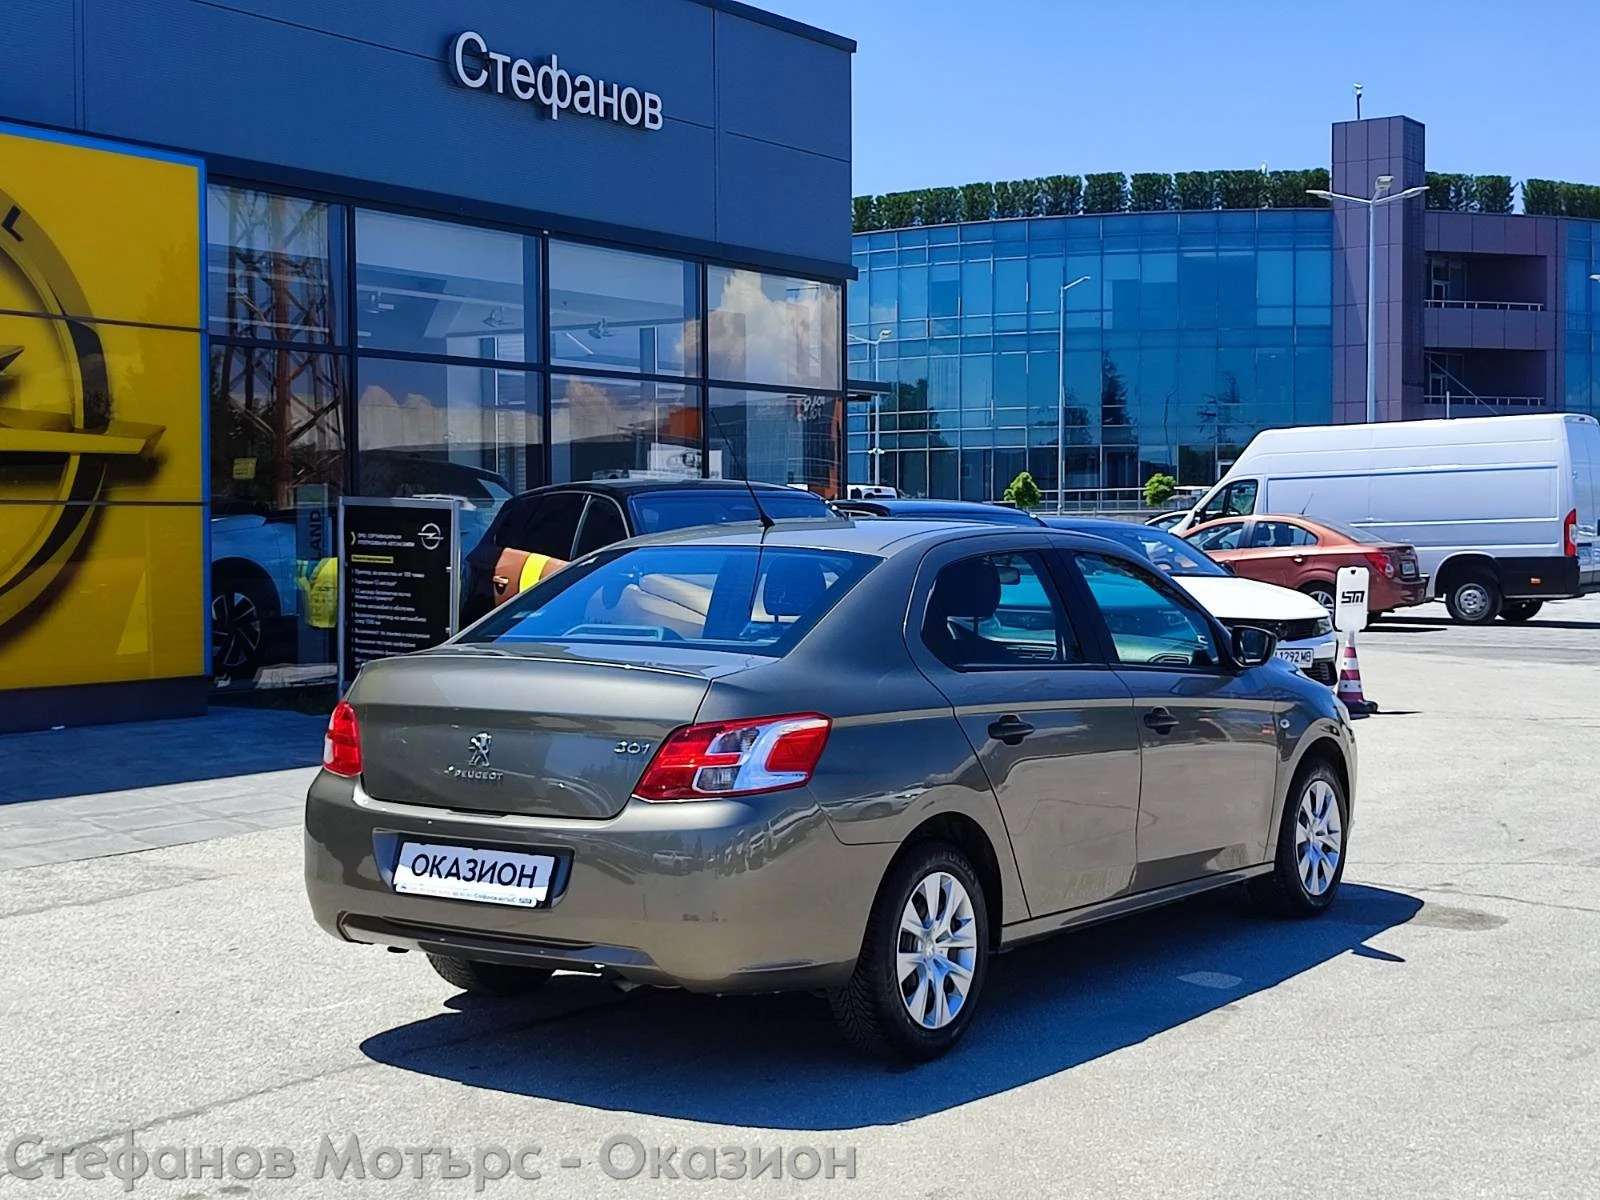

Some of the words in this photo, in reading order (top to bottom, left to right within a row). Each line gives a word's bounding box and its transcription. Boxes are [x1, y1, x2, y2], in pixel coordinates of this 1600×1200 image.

[454, 30, 664, 131] Стефанов
[614, 740, 651, 755] 301
[453, 768, 504, 780] PEUGEOT
[411, 853, 538, 889] ОКАЗИОН
